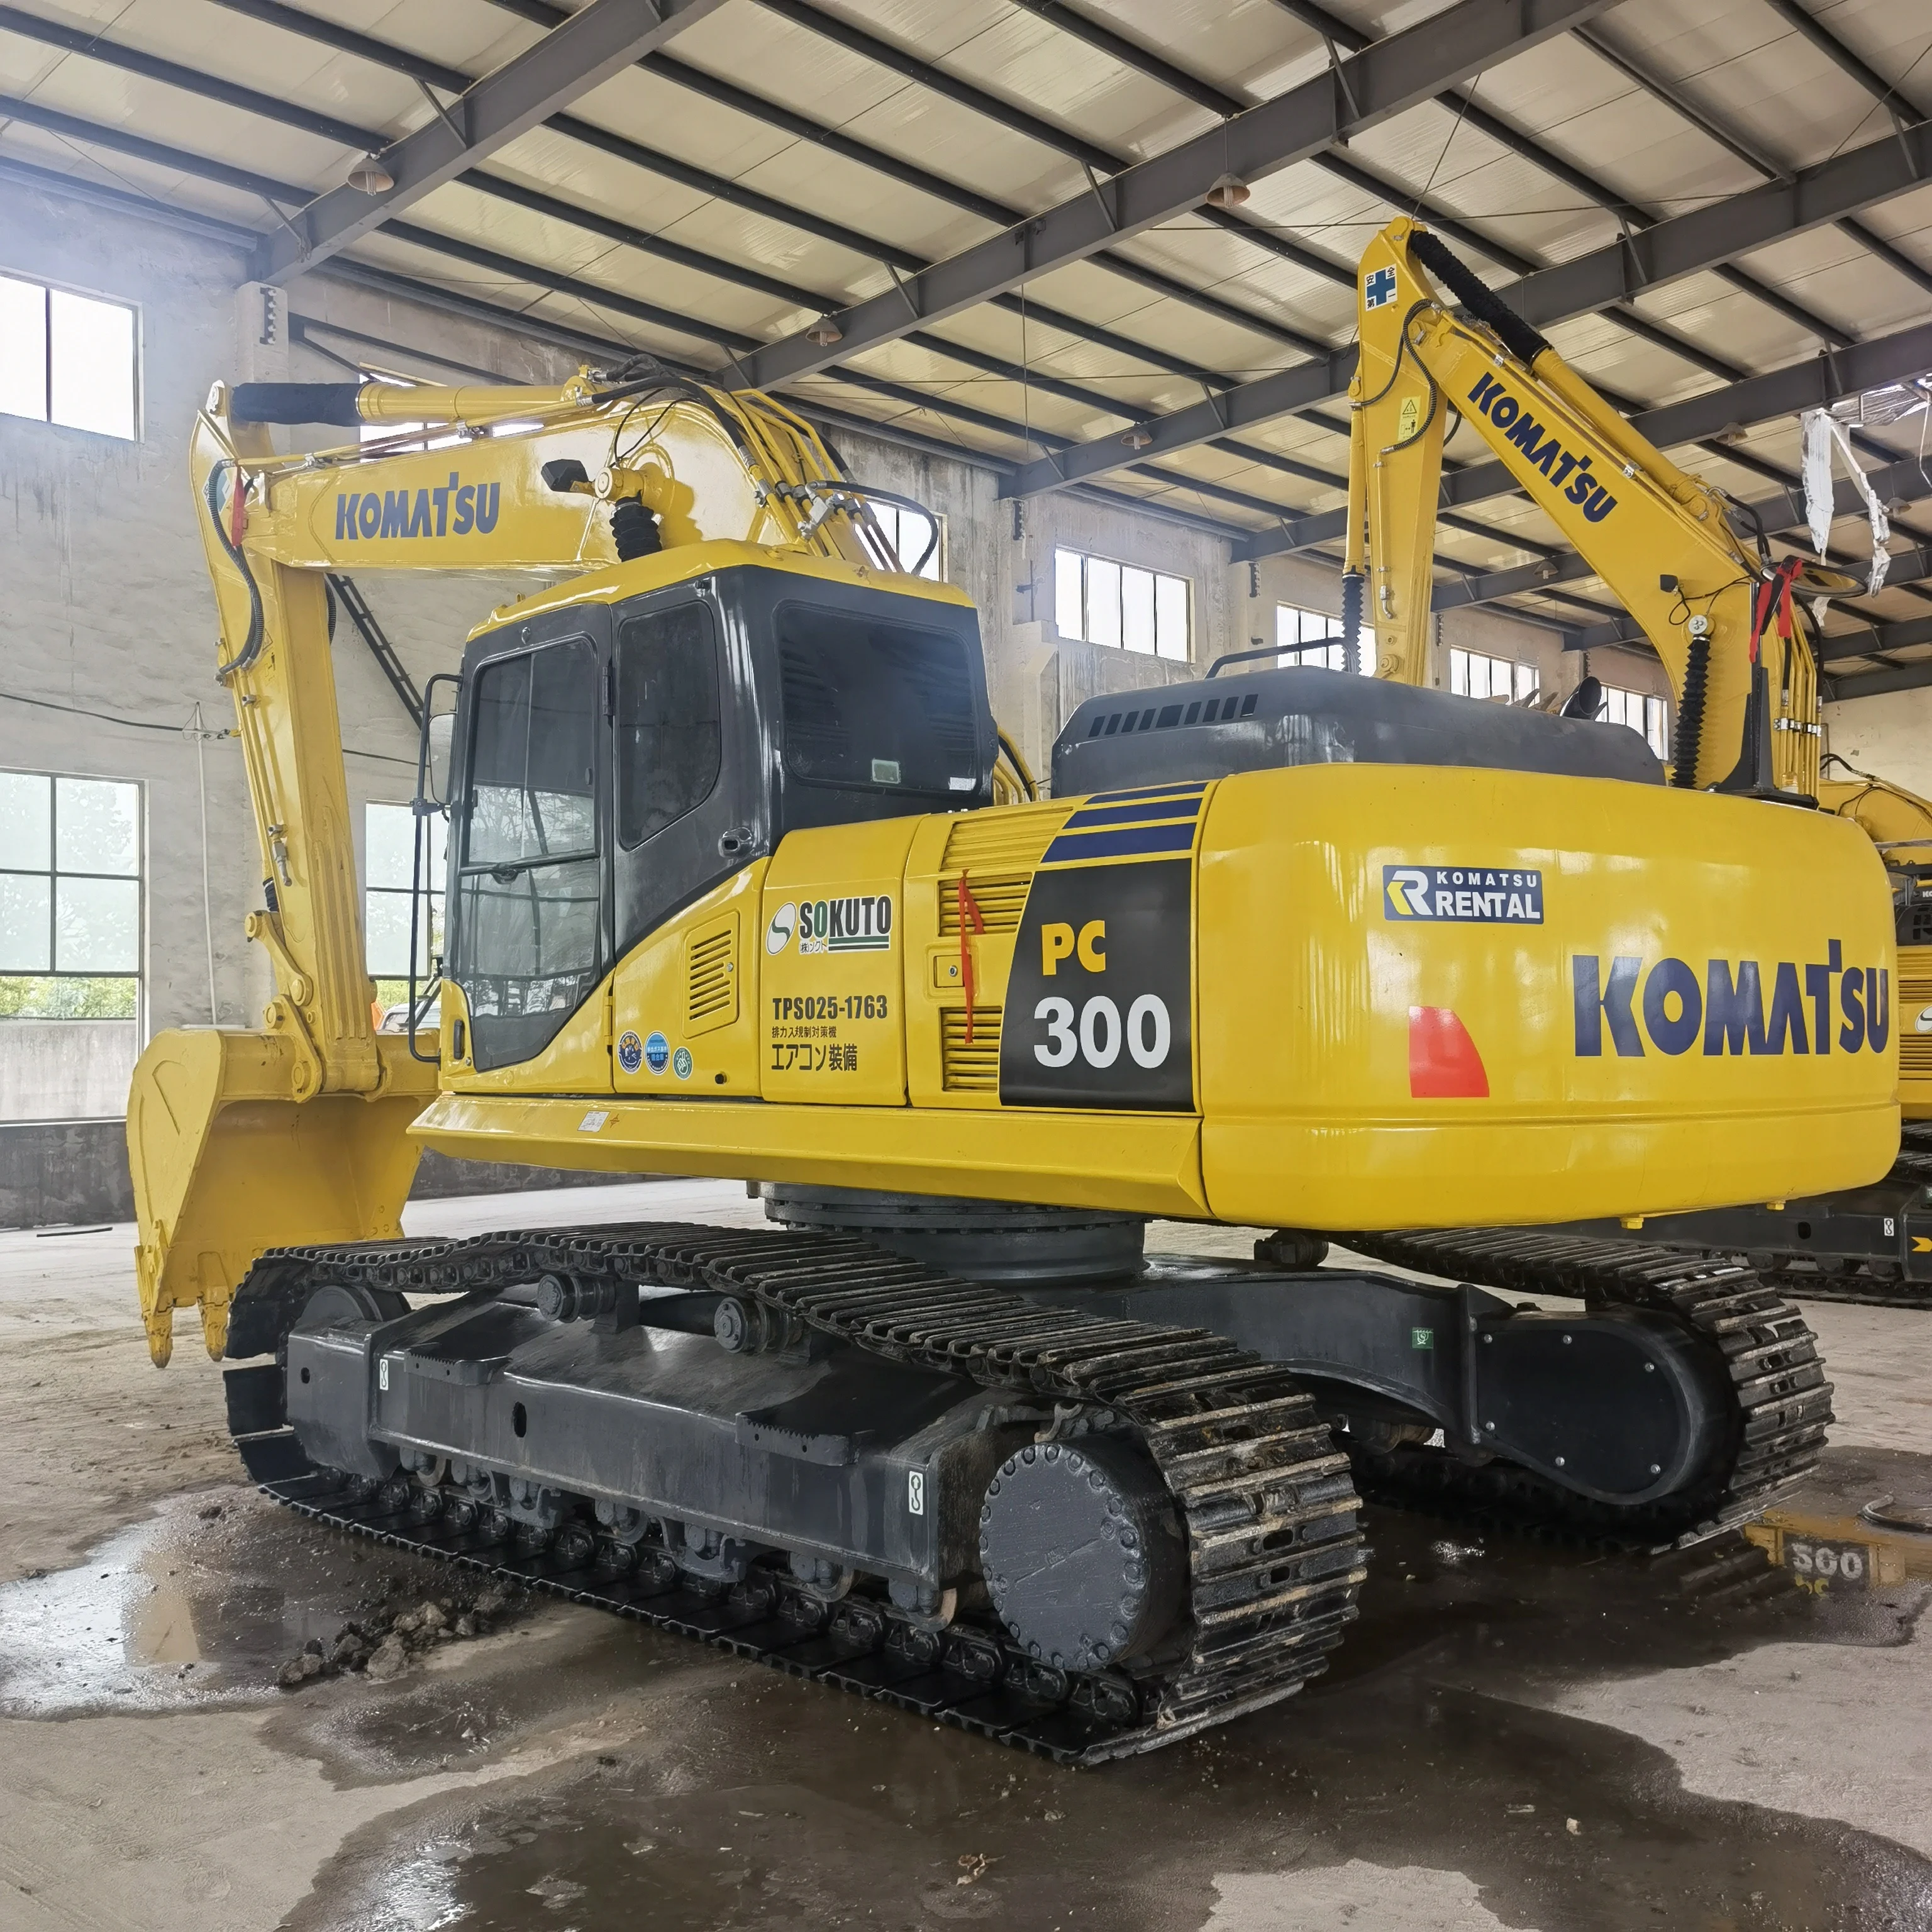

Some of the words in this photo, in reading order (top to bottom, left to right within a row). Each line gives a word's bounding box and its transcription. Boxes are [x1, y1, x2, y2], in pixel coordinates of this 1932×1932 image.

[1467, 371, 1618, 523] KOMATSU
[335, 472, 501, 540] KOMATSU
[1435, 891, 1541, 919] RENTAL
[1436, 872, 1537, 887] KOMATSU
[799, 896, 892, 939] SOKUTO
[1041, 919, 1106, 976] PC
[1572, 938, 1889, 1057] KOMATSU
[771, 1043, 858, 1072] エアコン装備
[1033, 994, 1171, 1069] 300
